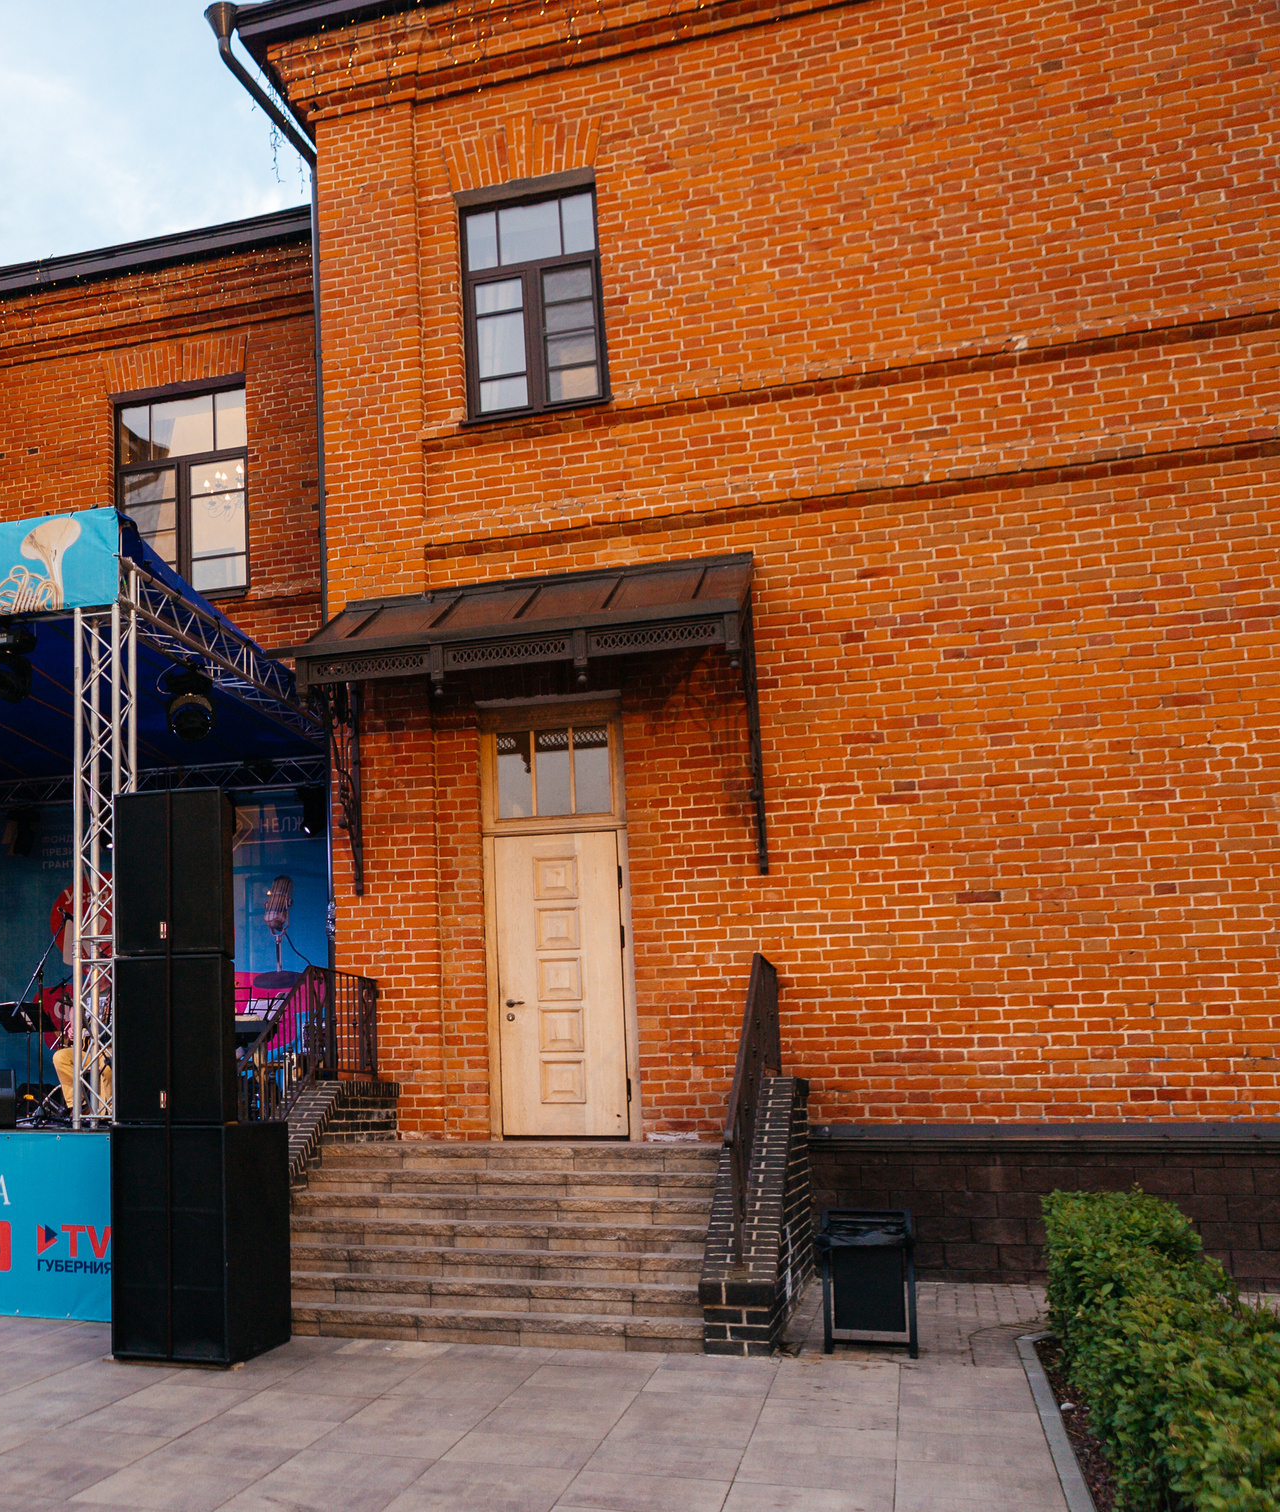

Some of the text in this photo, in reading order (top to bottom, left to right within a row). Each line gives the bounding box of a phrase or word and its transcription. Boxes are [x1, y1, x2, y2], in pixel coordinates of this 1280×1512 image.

[260, 815, 305, 834] НЕЛЖ
[61, 1225, 112, 1259] TV
[37, 1259, 112, 1275] ГУБЕРНИЯ
